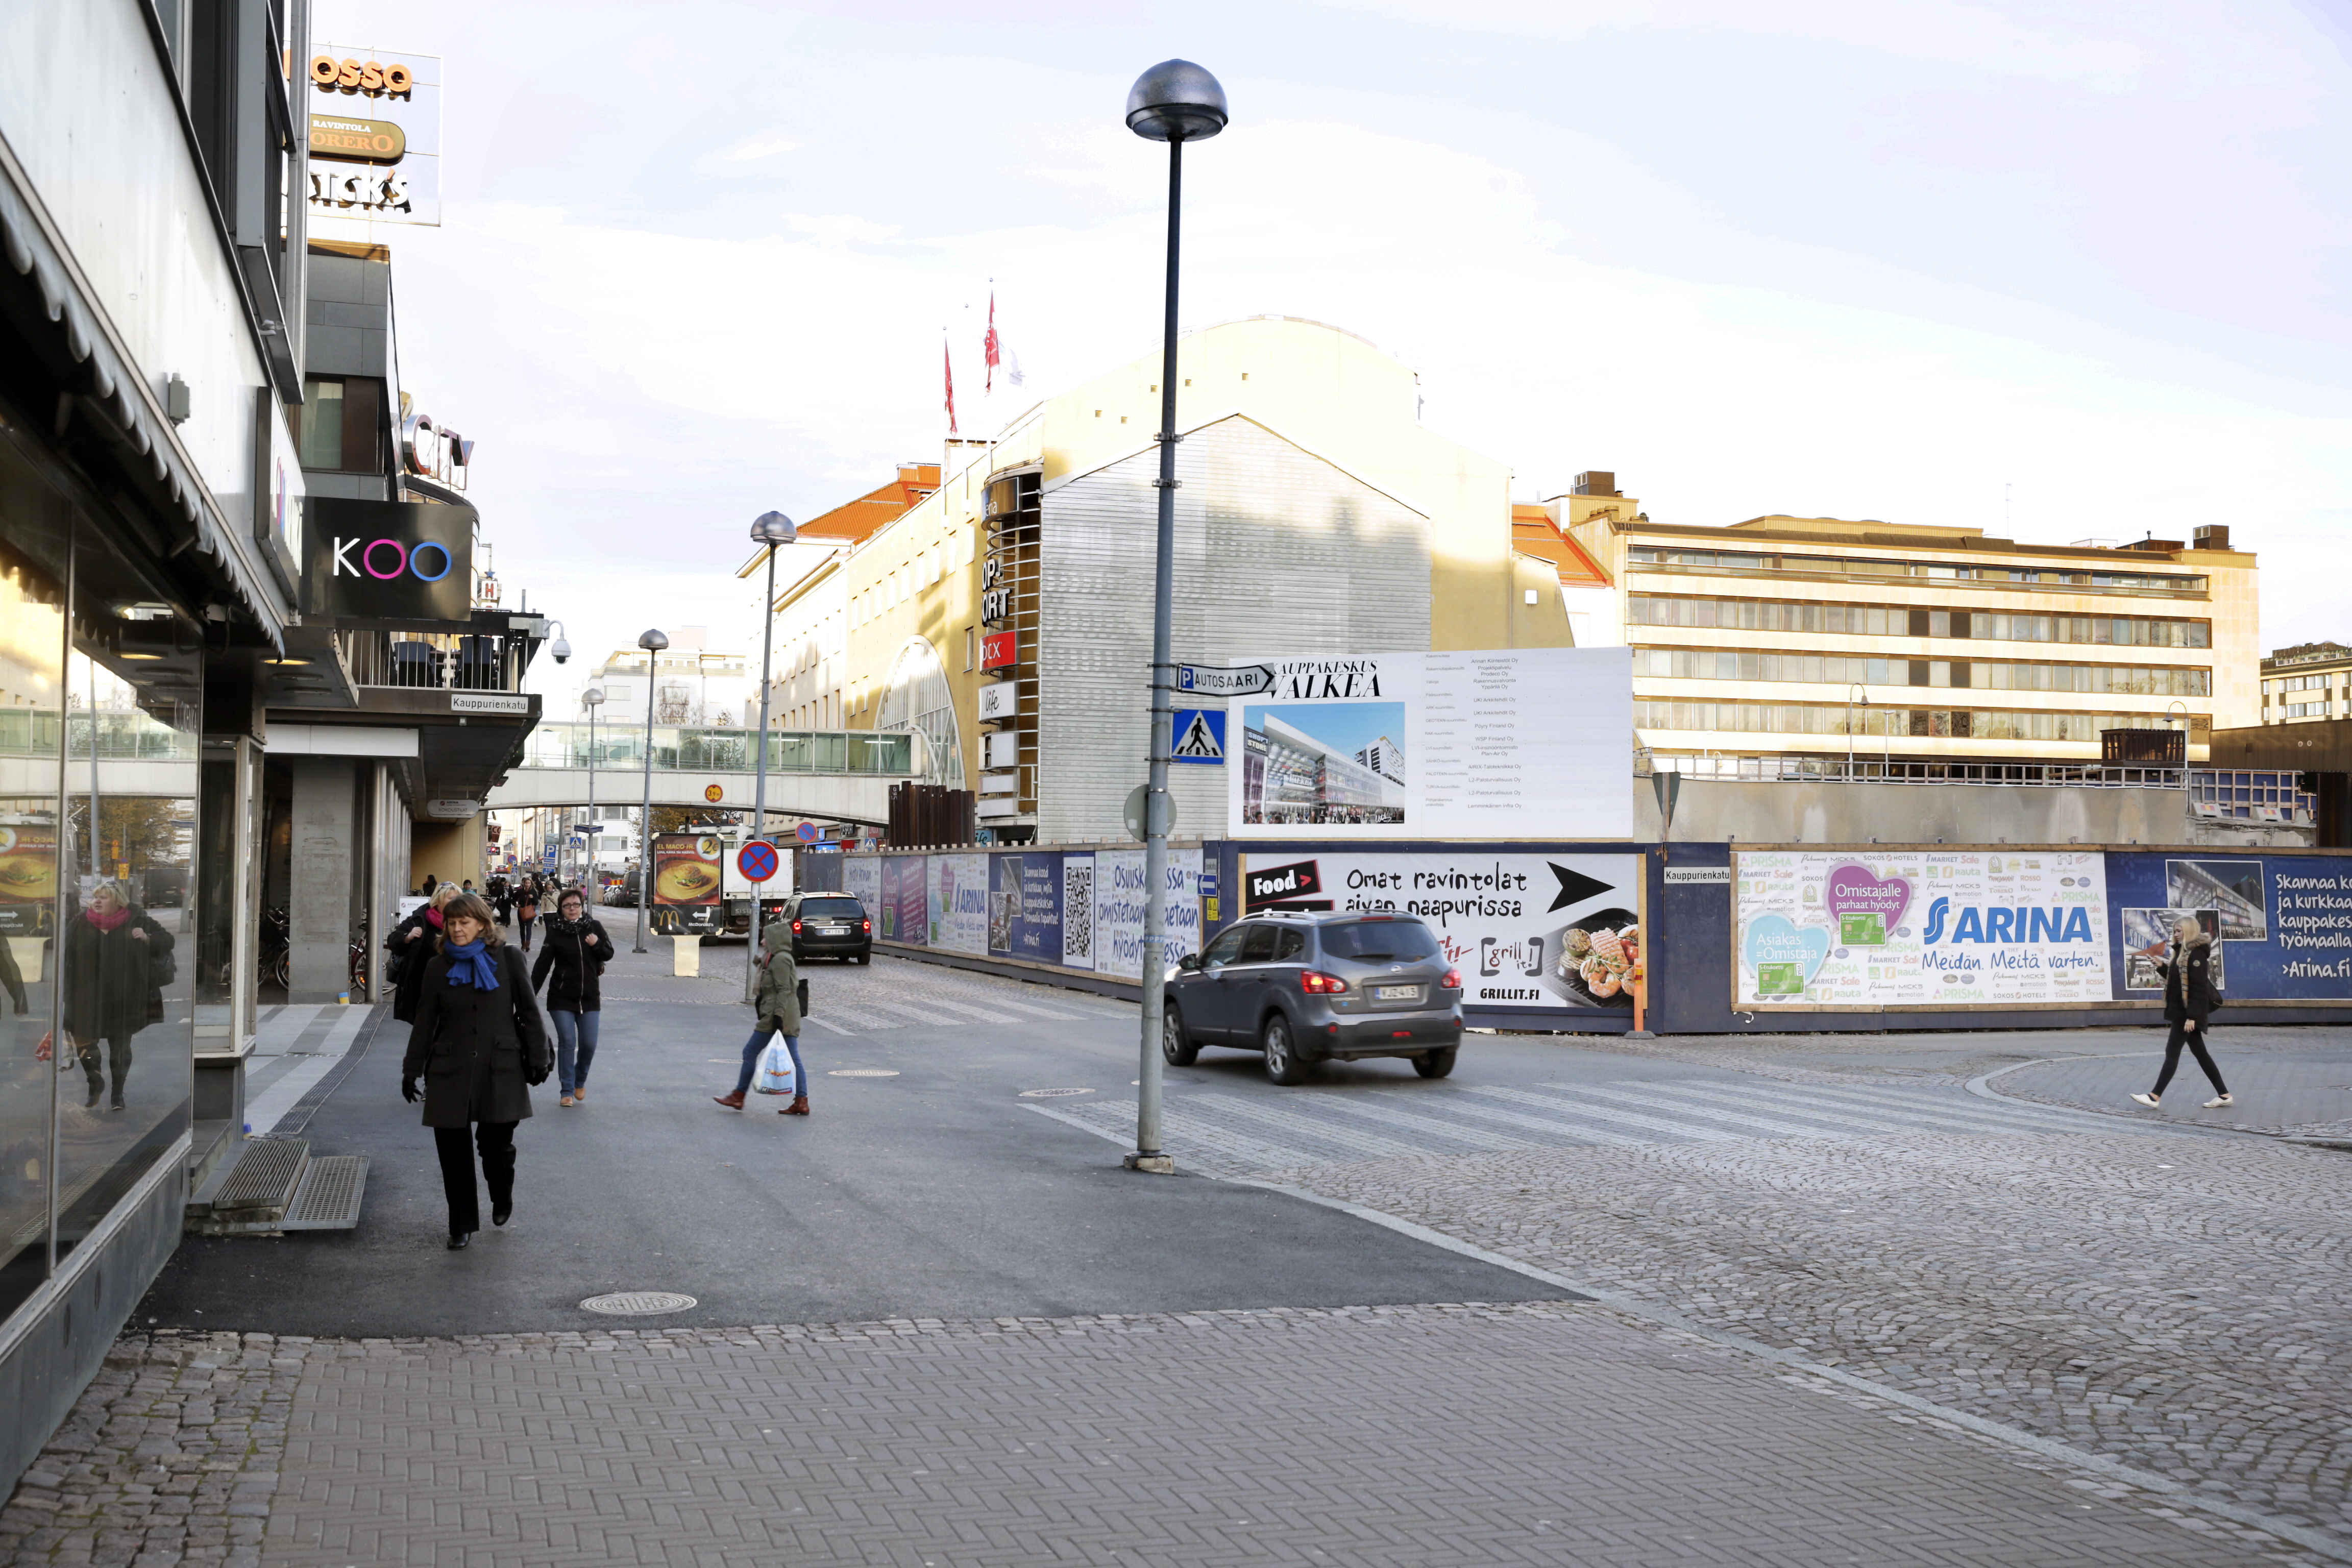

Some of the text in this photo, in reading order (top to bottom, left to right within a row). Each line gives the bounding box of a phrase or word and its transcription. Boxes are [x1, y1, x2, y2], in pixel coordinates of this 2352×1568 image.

[313, 120, 371, 133] RAVINTOLA
[310, 133, 395, 152] ORERO
[308, 166, 409, 206] ICK'S
[402, 414, 475, 490] CITY
[333, 537, 452, 582] KOO
[1195, 673, 1258, 688] AUTOSAARI
[453, 698, 526, 709] Kauppurienkatu
[975, 832, 988, 845] ife
[546, 845, 555, 856] P
[1751, 856, 1793, 867] PRISMA
[1961, 855, 1979, 864] Sale
[1254, 862, 1527, 896] Food Omat ravintolat
[1666, 870, 1729, 881] Kauppurienkatu
[1774, 869, 1793, 878] Sale
[2275, 873, 2337, 890] Skannaa
[1835, 884, 1901, 900] Omistajalle
[2062, 892, 2100, 902] PRISMA
[960, 889, 985, 914] ARINA
[1836, 899, 1900, 911] parhaat hyödyt
[2276, 890, 2292, 914] ja
[1407, 895, 1522, 928] naapurissa
[1951, 906, 2093, 943] ARINA
[2278, 913, 2352, 934] kauppakes
[1756, 933, 1801, 945] Asiakas
[2278, 930, 2352, 950] työmaalla
[1922, 950, 2098, 970] Meidän. Meitä varten.
[1841, 976, 1860, 985] Sale
[1480, 988, 1539, 1000] GRILLIT.FI
[1944, 989, 1985, 999] PRISMA
